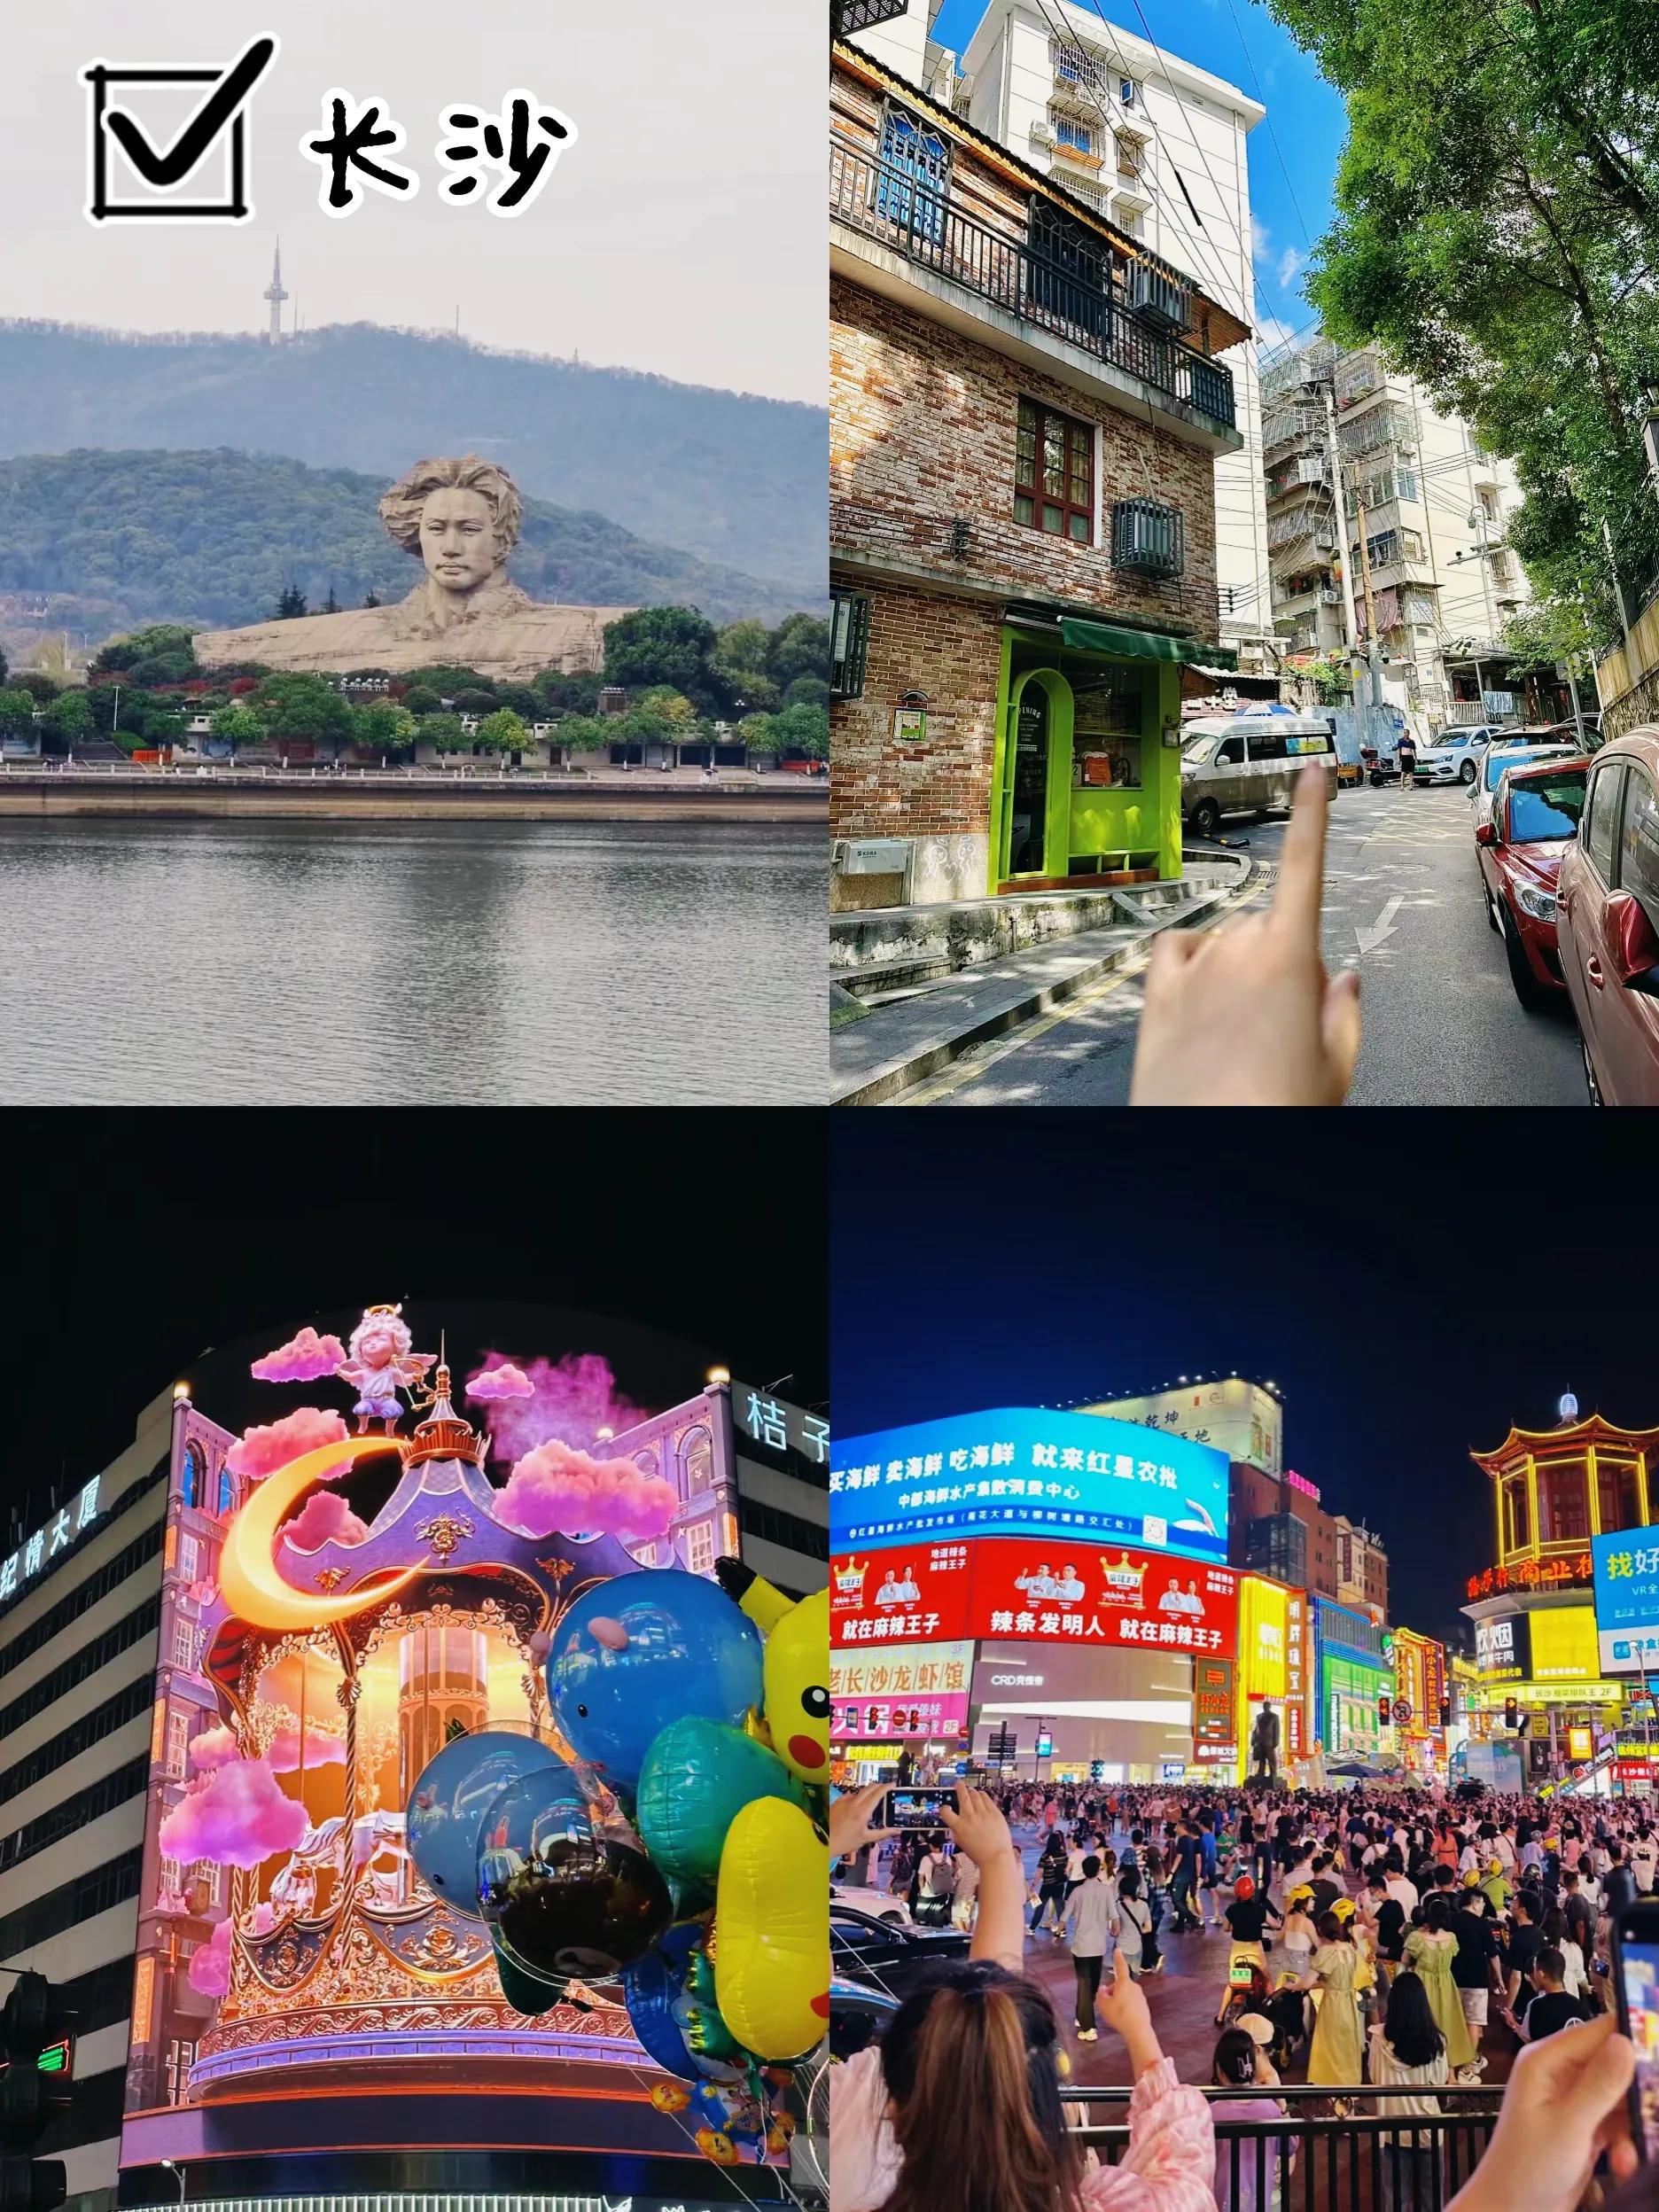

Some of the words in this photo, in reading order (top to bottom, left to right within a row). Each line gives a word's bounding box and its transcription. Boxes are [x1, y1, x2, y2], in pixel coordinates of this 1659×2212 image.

[747, 1392, 830, 1463] 桔子
[949, 1442, 1015, 1472] 吃海鲜
[1032, 1443, 1178, 1490] 就来红星农批
[842, 1613, 939, 1641] 就在麻辣王子
[991, 1610, 1105, 1637] 辣条发明人
[1119, 1618, 1223, 1649] 就在麻辣王子
